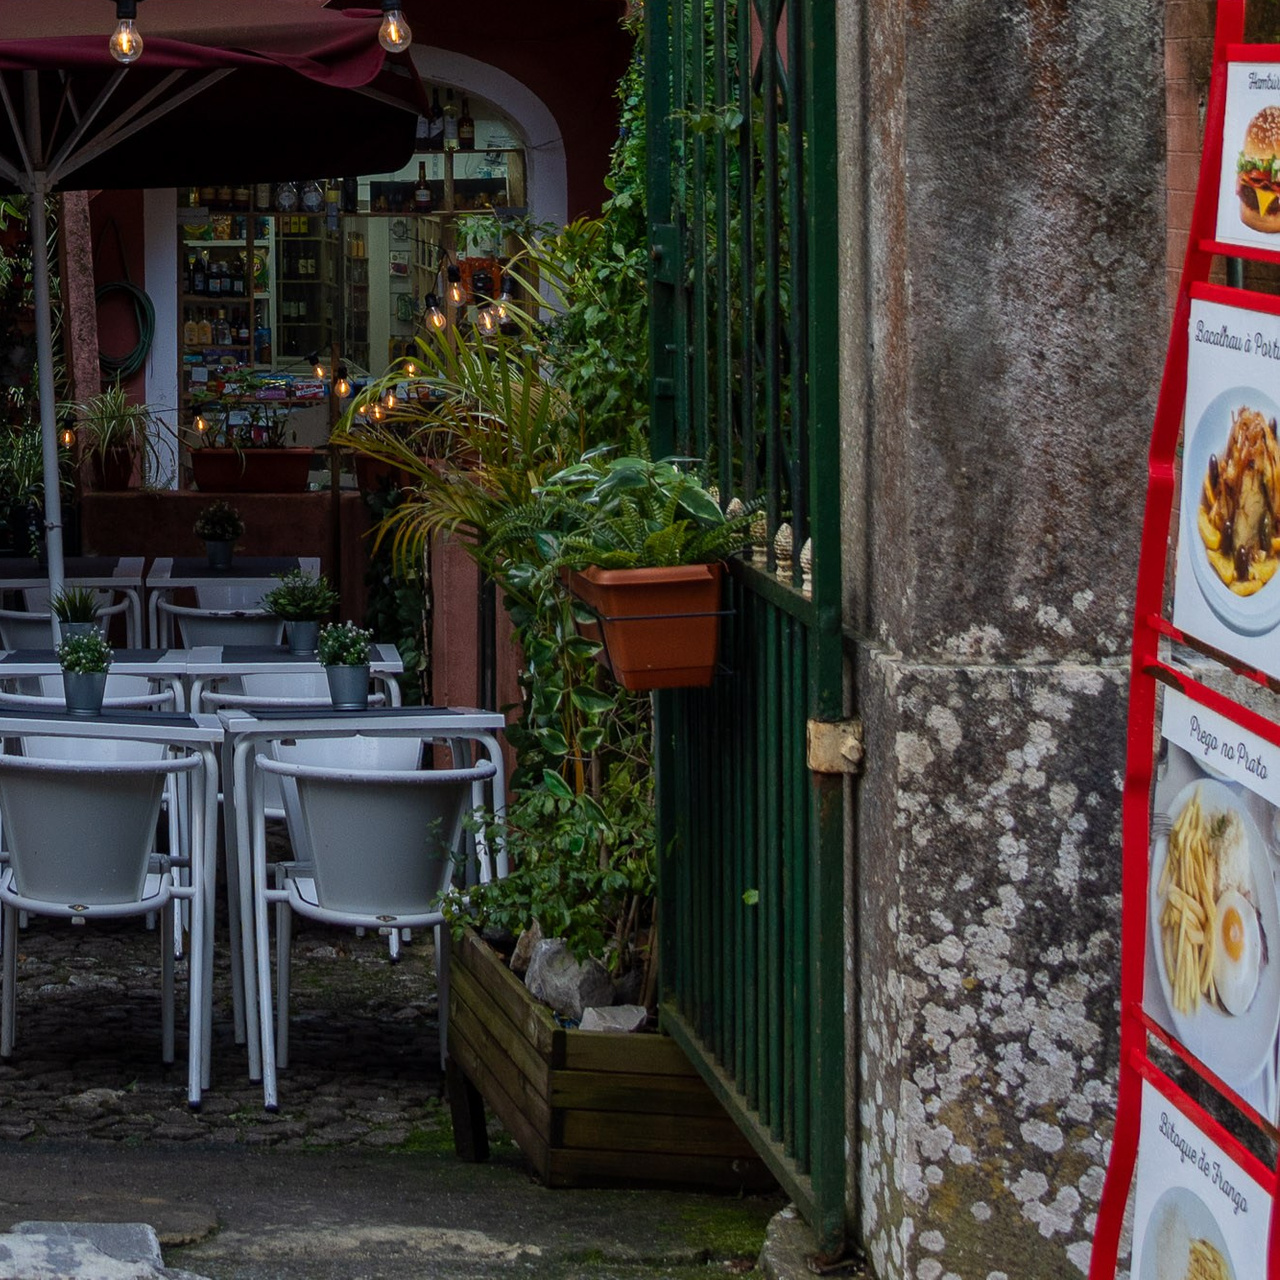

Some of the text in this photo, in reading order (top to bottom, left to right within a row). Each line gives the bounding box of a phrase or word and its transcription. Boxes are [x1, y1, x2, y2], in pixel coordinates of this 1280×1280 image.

[1194, 319, 1243, 351] Bacalhau
[1244, 332, 1252, 352] à
[1189, 715, 1268, 780] Prego no Prato
[1158, 1111, 1248, 1215] Bitoque de Frango
